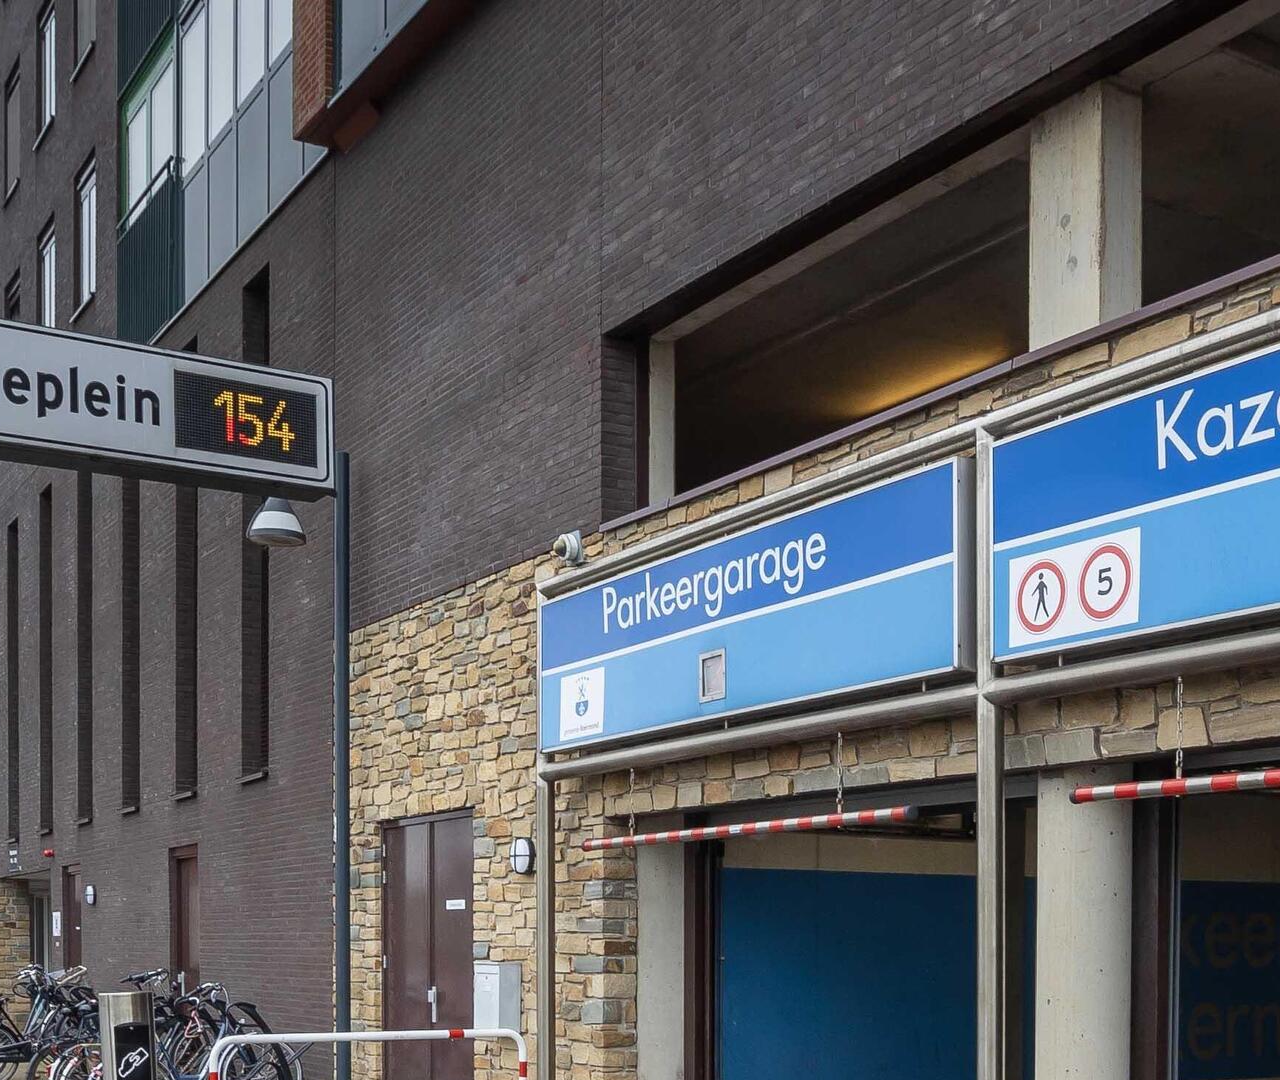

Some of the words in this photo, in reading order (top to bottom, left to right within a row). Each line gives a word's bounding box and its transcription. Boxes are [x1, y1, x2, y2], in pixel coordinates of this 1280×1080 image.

[213, 390, 296, 451] 154
[602, 533, 826, 634] Parkeergarage
[1097, 566, 1113, 596] 5
